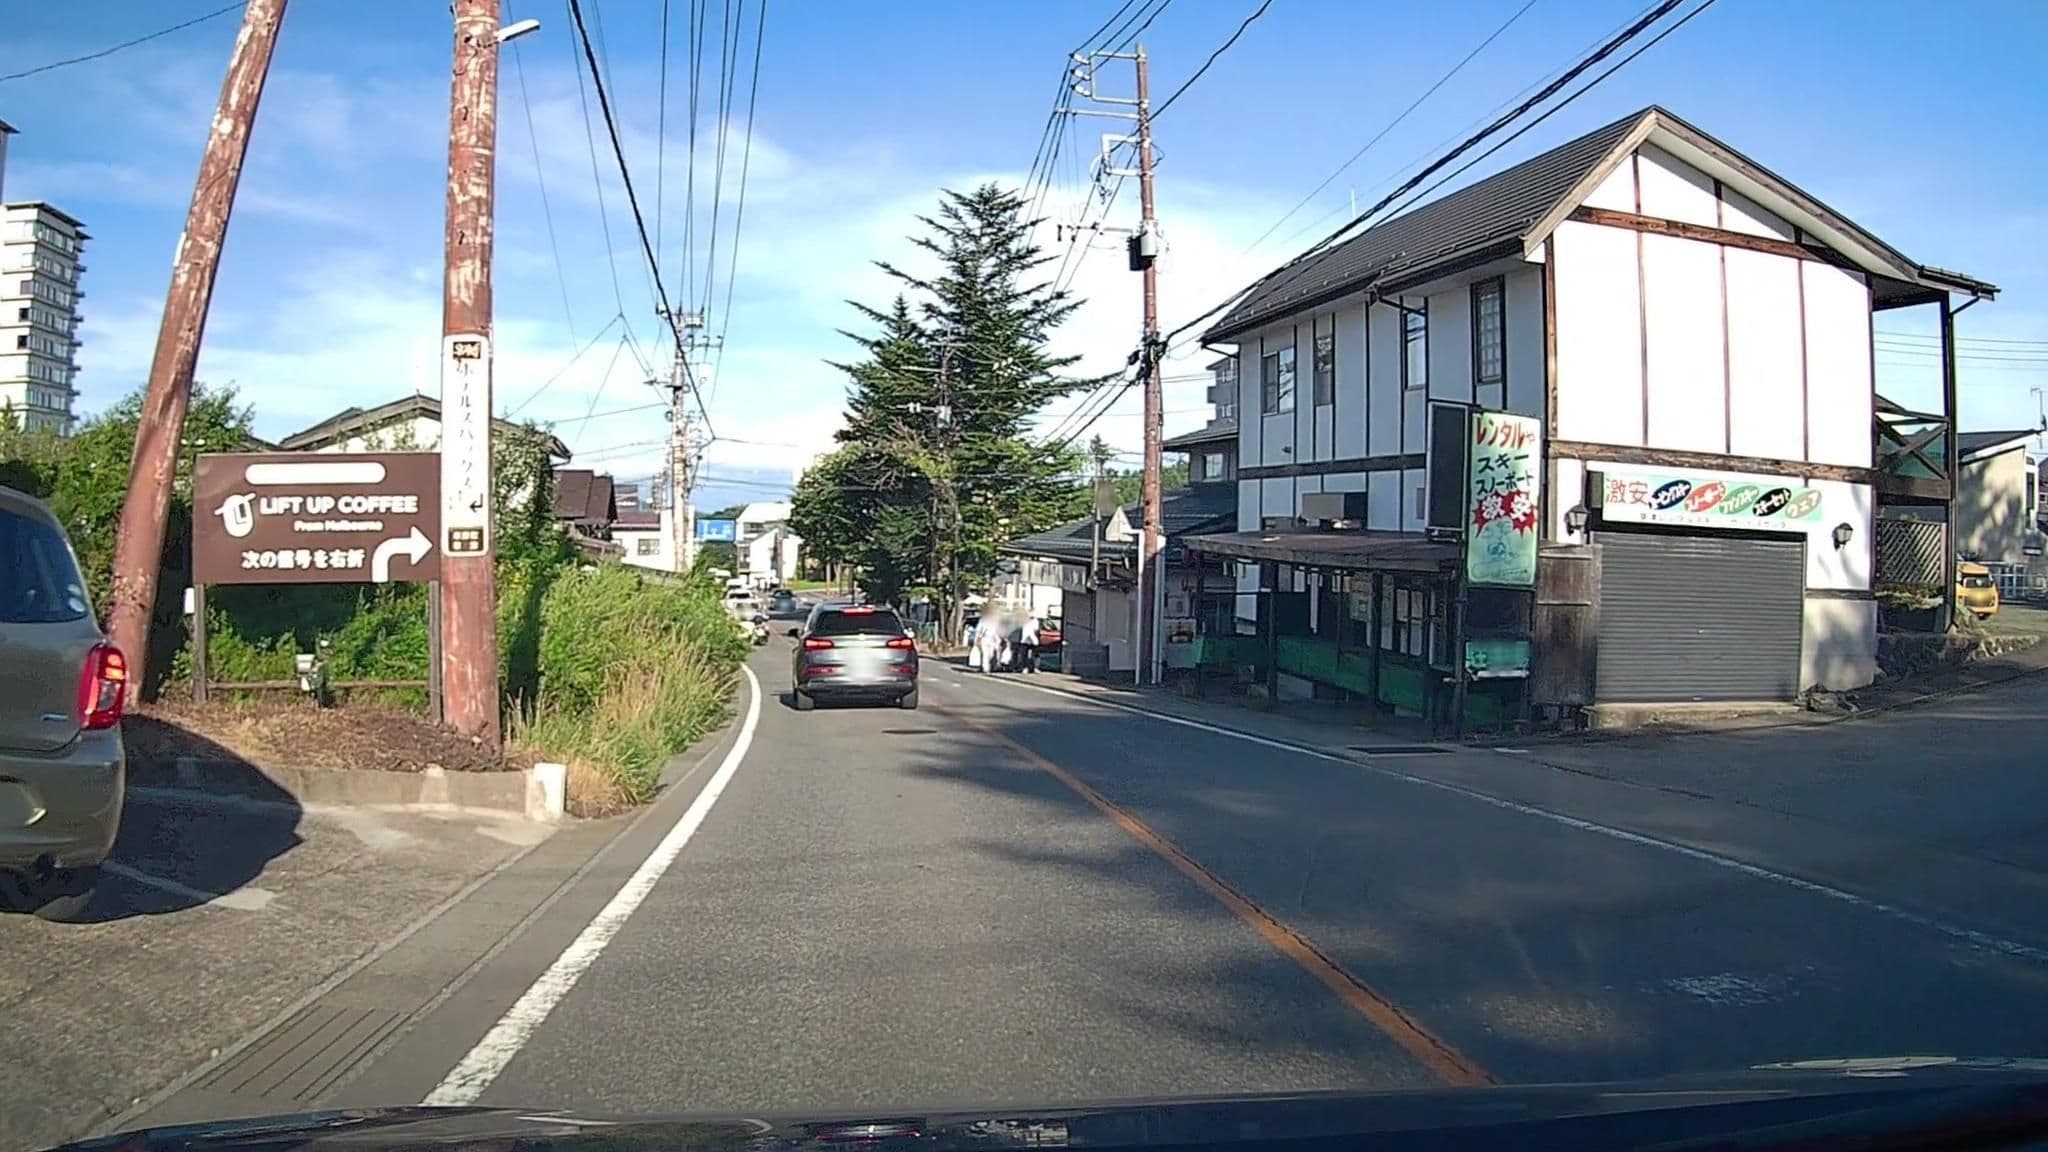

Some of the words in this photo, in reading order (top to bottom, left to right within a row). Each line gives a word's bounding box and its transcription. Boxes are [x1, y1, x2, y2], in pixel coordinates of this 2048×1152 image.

[1477, 453, 1529, 474] スキー
[1605, 478, 1648, 505] 激安
[260, 496, 303, 514] LIFT
[307, 496, 335, 514] UP
[338, 495, 418, 514] COFFEE
[1482, 493, 1532, 523] 激安
[242, 549, 365, 568] 次の信号を右折
